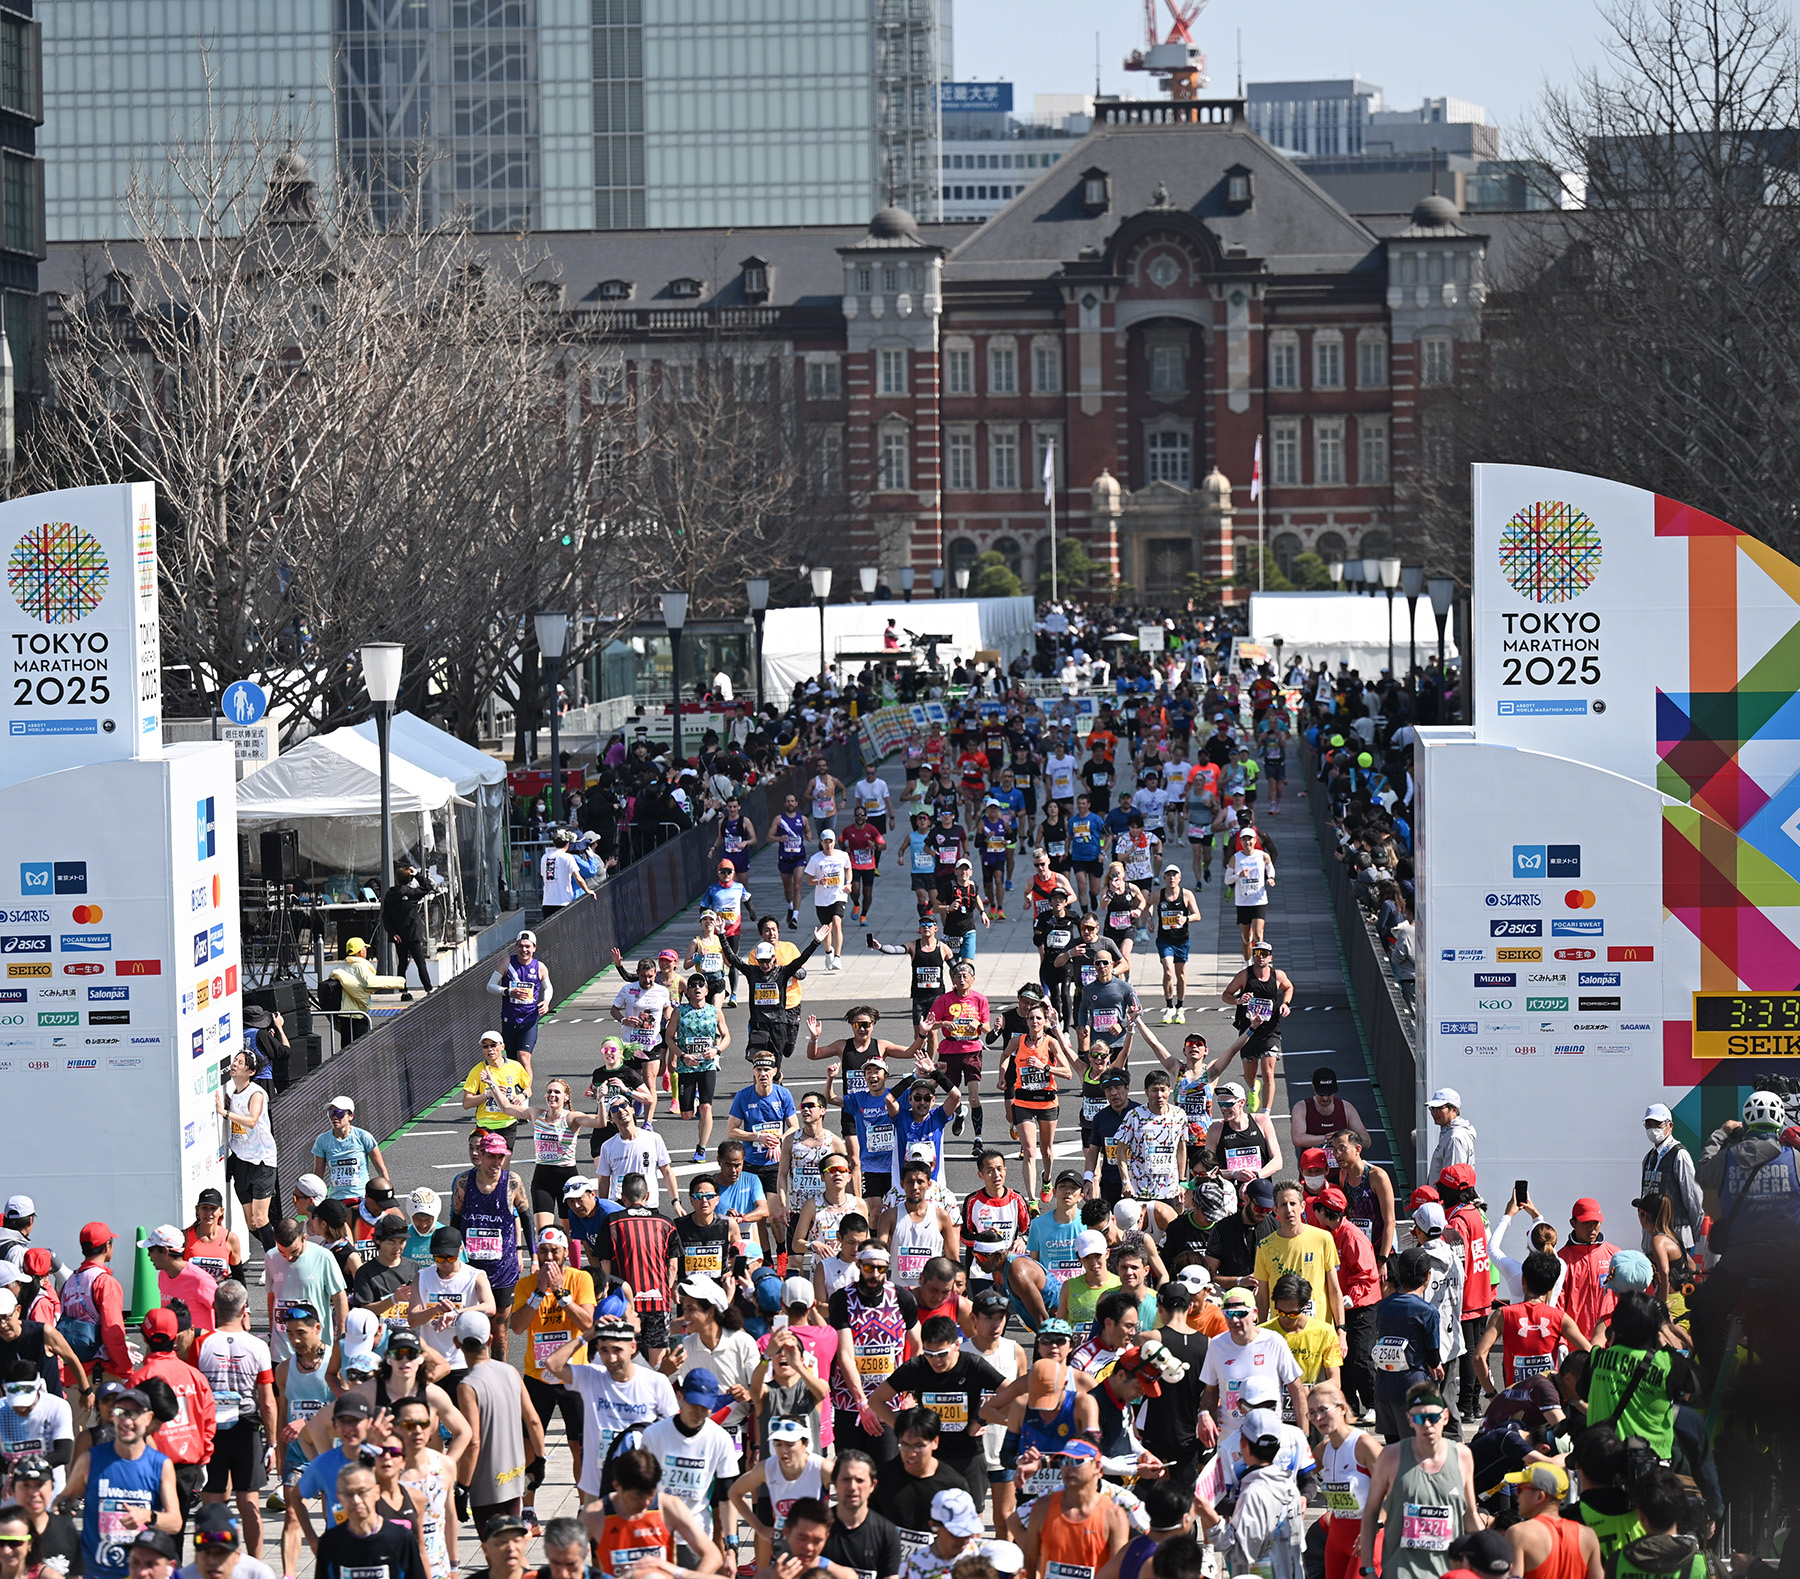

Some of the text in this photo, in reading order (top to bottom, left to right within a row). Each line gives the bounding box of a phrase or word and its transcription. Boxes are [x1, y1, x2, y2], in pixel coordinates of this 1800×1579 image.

[1502, 611, 1601, 634] TOKYO
[12, 632, 109, 655] TOKYO
[1503, 638, 1599, 653] MARATHON
[14, 658, 108, 673] MARATHON
[1502, 656, 1601, 686] 2025
[13, 676, 110, 706] 2025
[1508, 924, 1537, 934] asics
[18, 939, 46, 950] asics
[1497, 950, 1541, 960] SEIKO
[1558, 950, 1592, 959] 第一生命
[8, 965, 51, 976] SEIKO
[67, 965, 101, 973] 第一生命
[1480, 975, 1511, 983] MIZUHO
[1528, 974, 1567, 983] こくみん共済
[1580, 975, 1617, 986] Salonpas
[38, 988, 77, 998] こくみん共済
[89, 989, 126, 1001] Salonpas
[759, 990, 777, 998] 30573
[1528, 999, 1567, 1009] バスクリン
[0, 1015, 24, 1025] ao
[39, 1014, 78, 1024] バスクリン
[1441, 1023, 1478, 1033] 日本光電
[1728, 1035, 1800, 1055] SEIK
[67, 1059, 97, 1067] HIBINO
[1027, 1072, 1046, 1083] 12841
[872, 1132, 892, 1143] 25107
[537, 1141, 559, 1151] 25708
[1152, 1154, 1172, 1165] 26674
[1234, 1156, 1256, 1168] 23436
[800, 1176, 820, 1186] 27761
[696, 1247, 719, 1255] 東京メトロ
[693, 1255, 718, 1268] 22195
[541, 1305, 563, 1315] Julio
[542, 1315, 564, 1326] フリオ
[1379, 1349, 1401, 1360] 25604
[861, 1358, 889, 1370] 25088
[1526, 1357, 1550, 1365] 東京メトロ
[172, 1383, 198, 1396] ICAL
[936, 1394, 963, 1402] 東京メトロ
[677, 1458, 705, 1468] 東京メトロ
[669, 1469, 701, 1484] 27414
[1421, 1508, 1449, 1518] 東京メトロ
[1414, 1518, 1446, 1536] 12321
[901, 1531, 928, 1542] 東京メトロ
[1060, 1566, 1091, 1578] 東京メトロ
